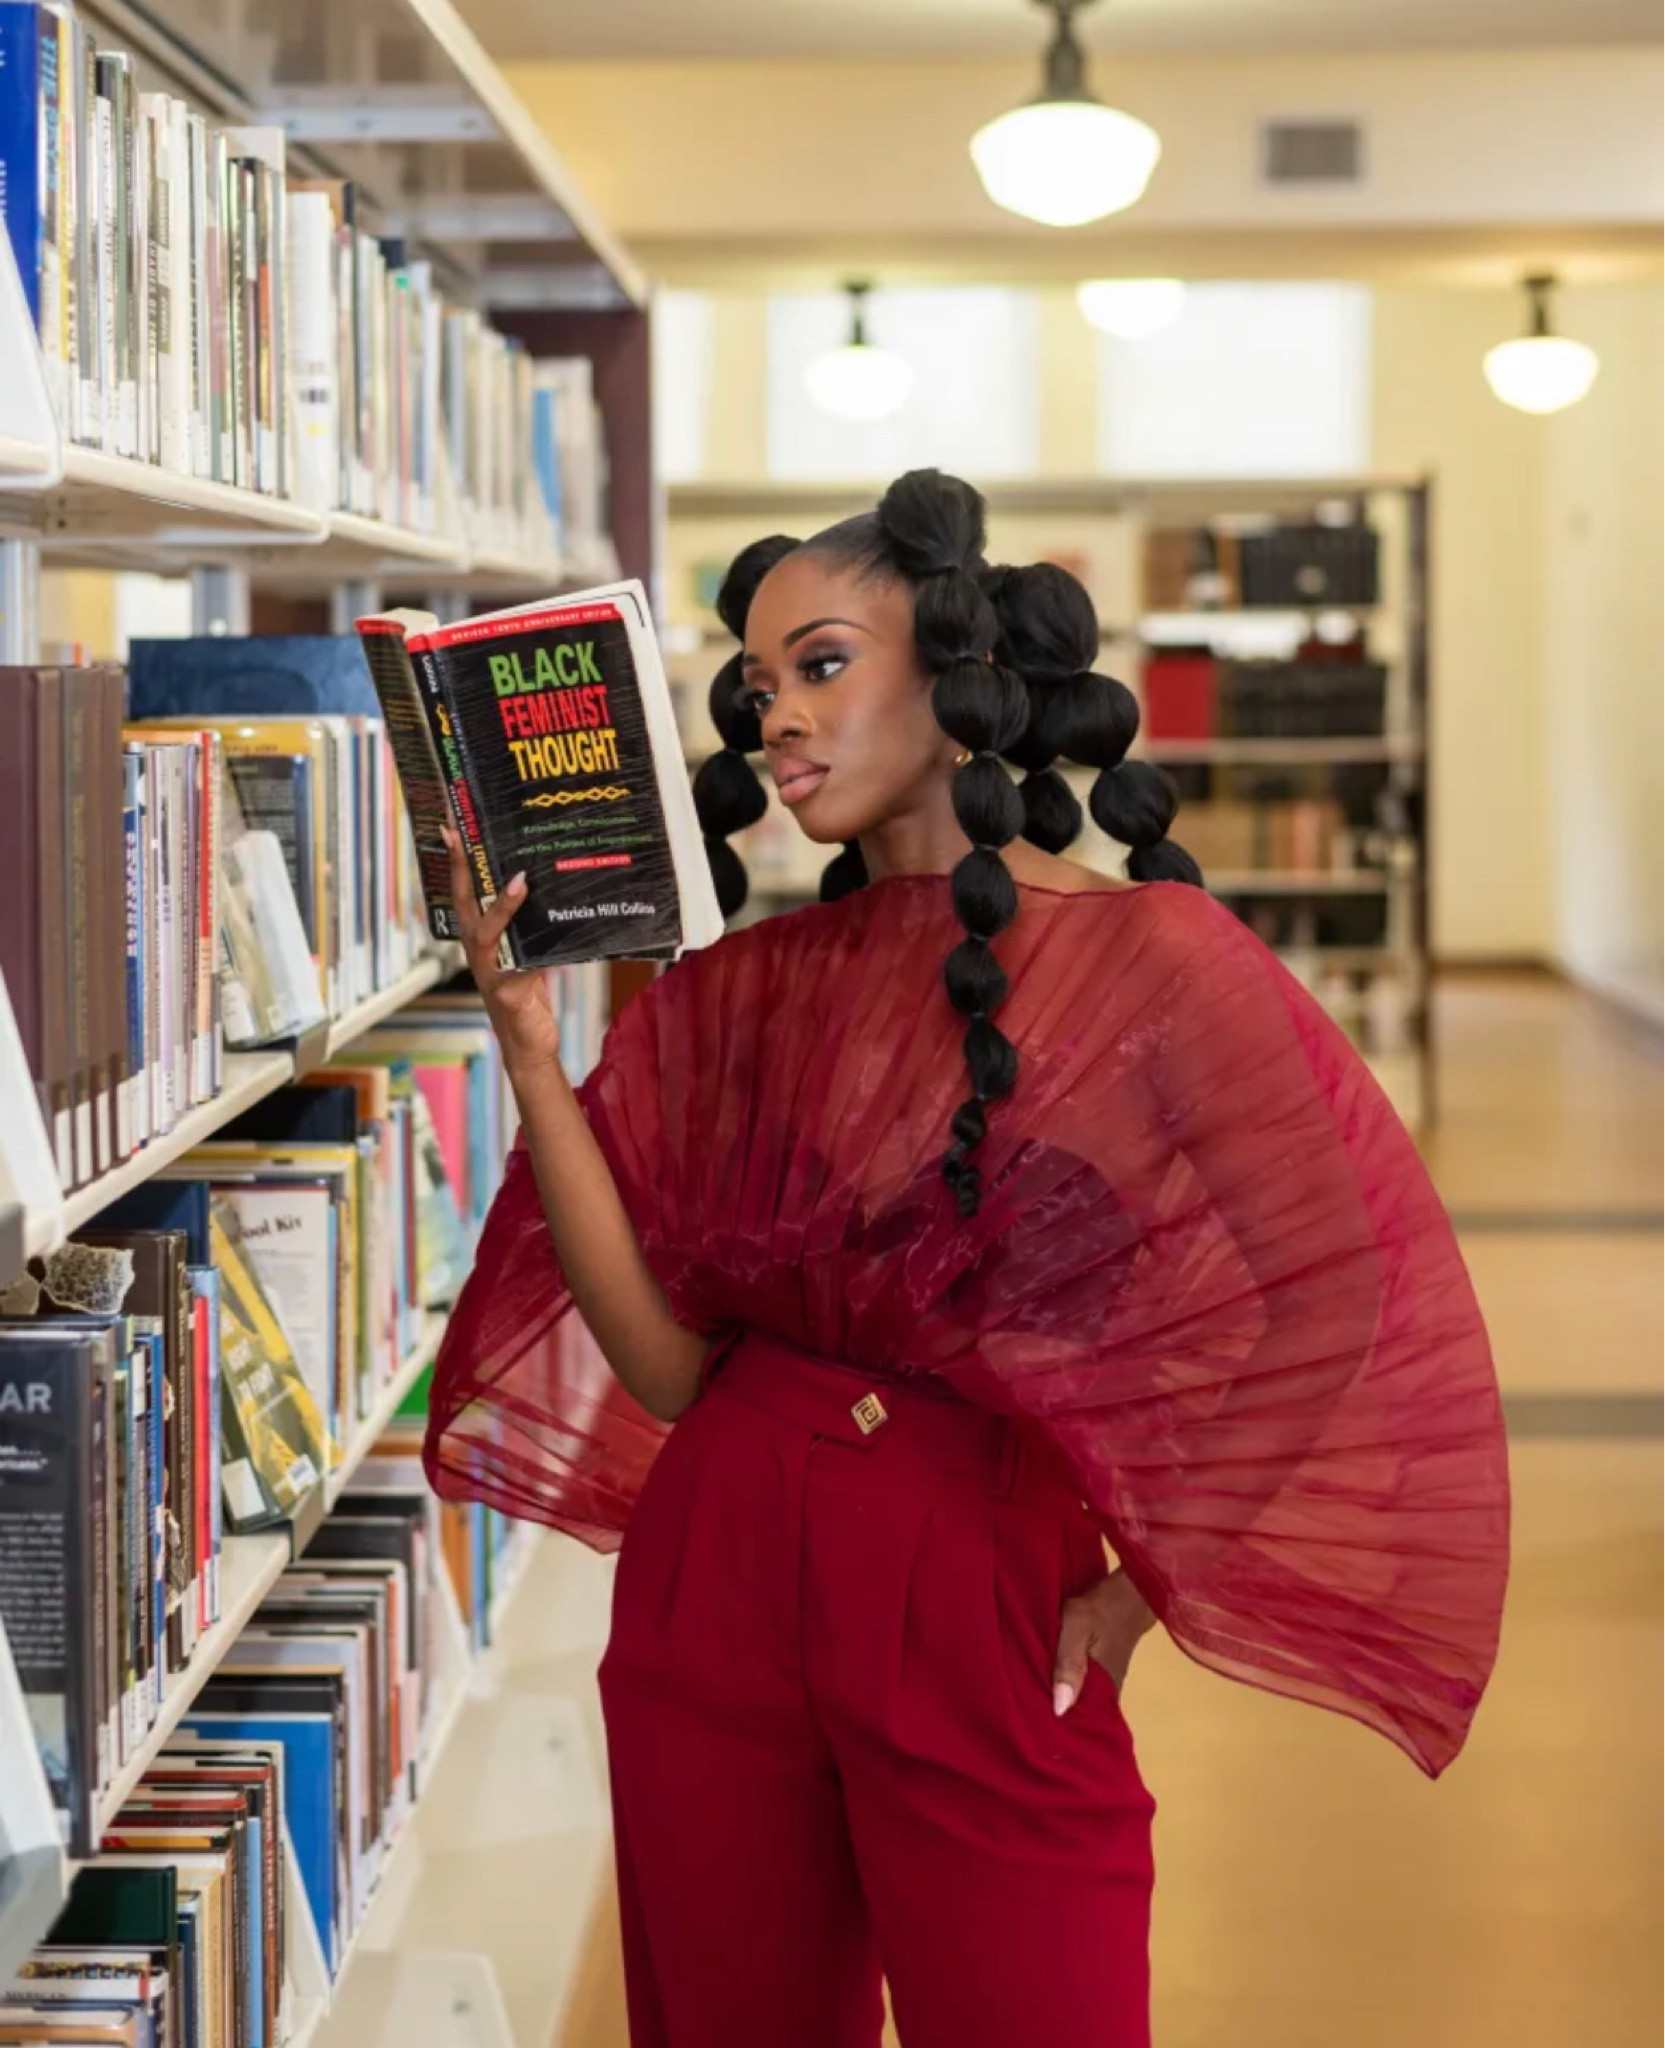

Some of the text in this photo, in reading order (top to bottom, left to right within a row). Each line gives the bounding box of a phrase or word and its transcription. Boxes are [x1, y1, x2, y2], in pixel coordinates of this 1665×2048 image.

[488, 641, 603, 696] BLACK
[499, 684, 611, 738] FEMINIST
[508, 728, 619, 780] THOUGHT
[548, 902, 656, 922] Patricia Hill Collins
